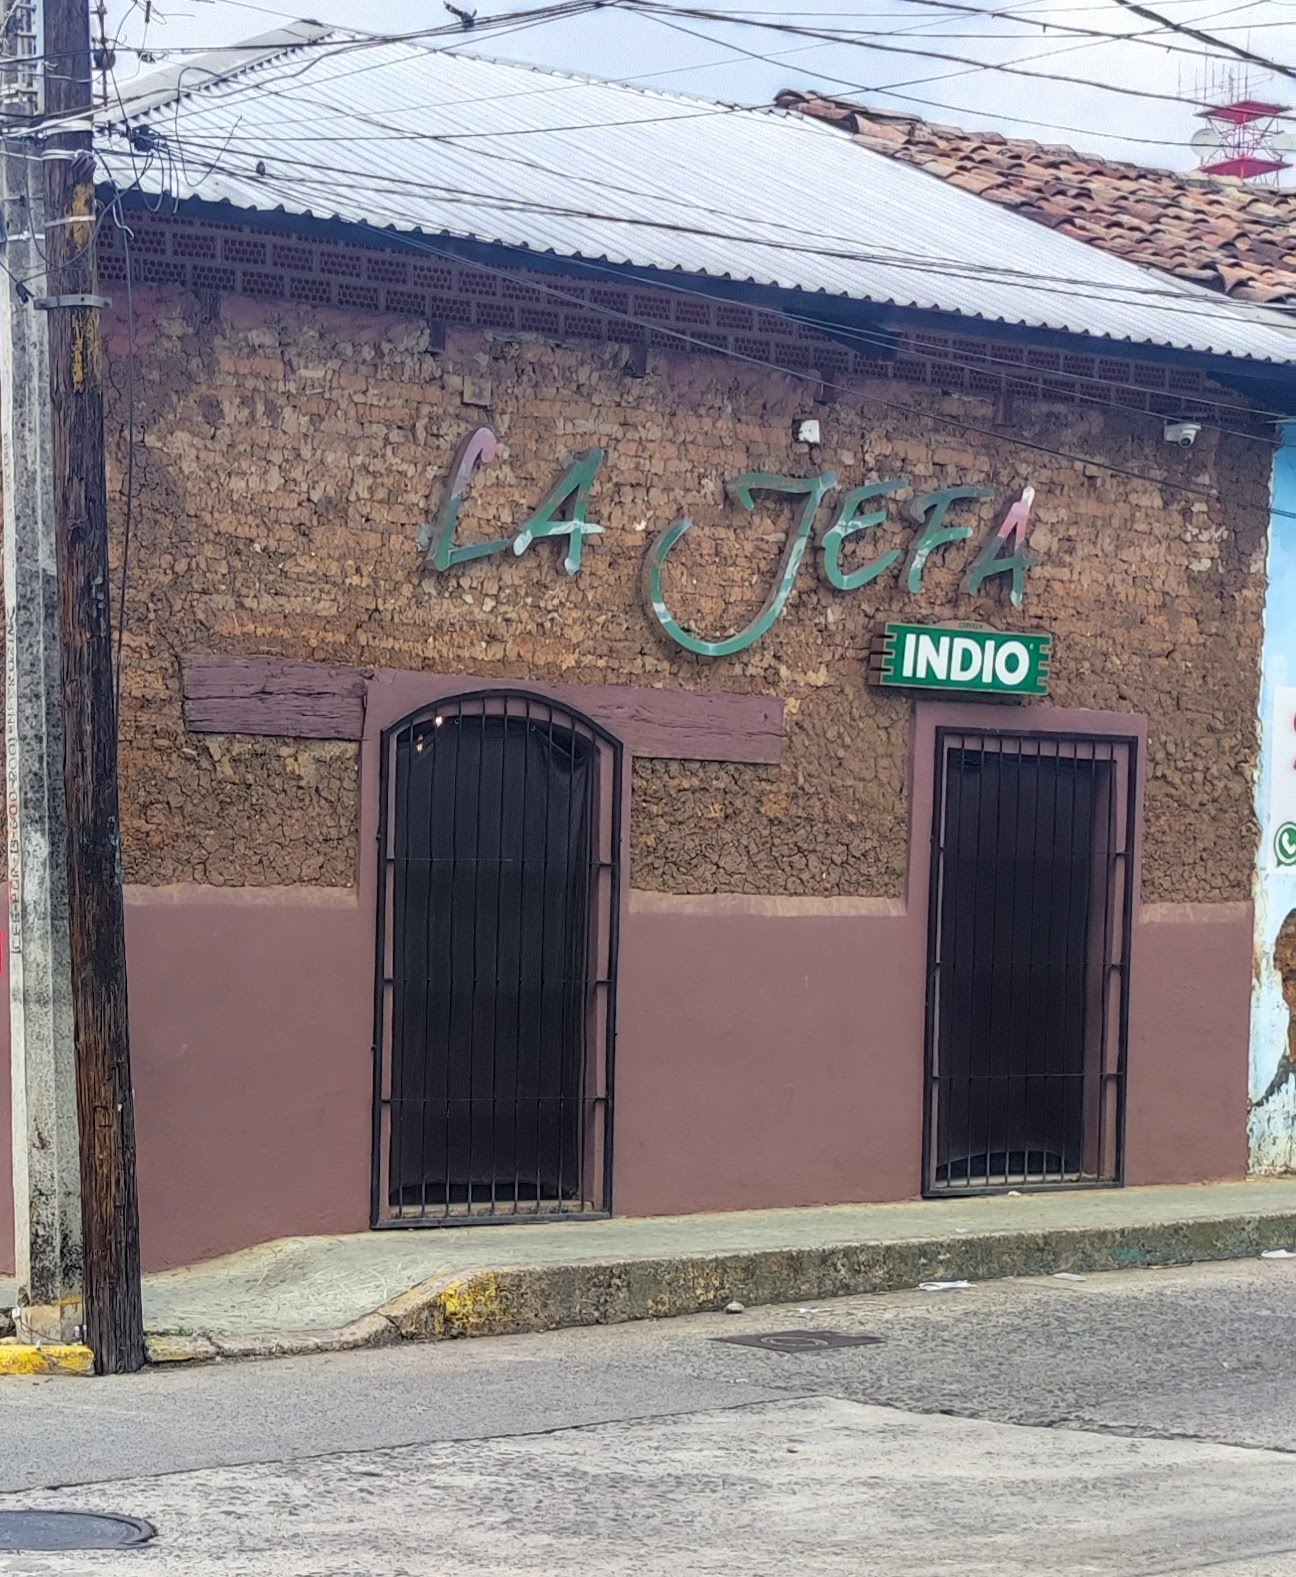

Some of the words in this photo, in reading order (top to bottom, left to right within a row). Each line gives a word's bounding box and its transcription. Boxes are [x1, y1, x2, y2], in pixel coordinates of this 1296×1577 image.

[424, 427, 603, 576] LA
[642, 470, 1040, 657] JEFA
[902, 632, 1031, 686] INDIO
